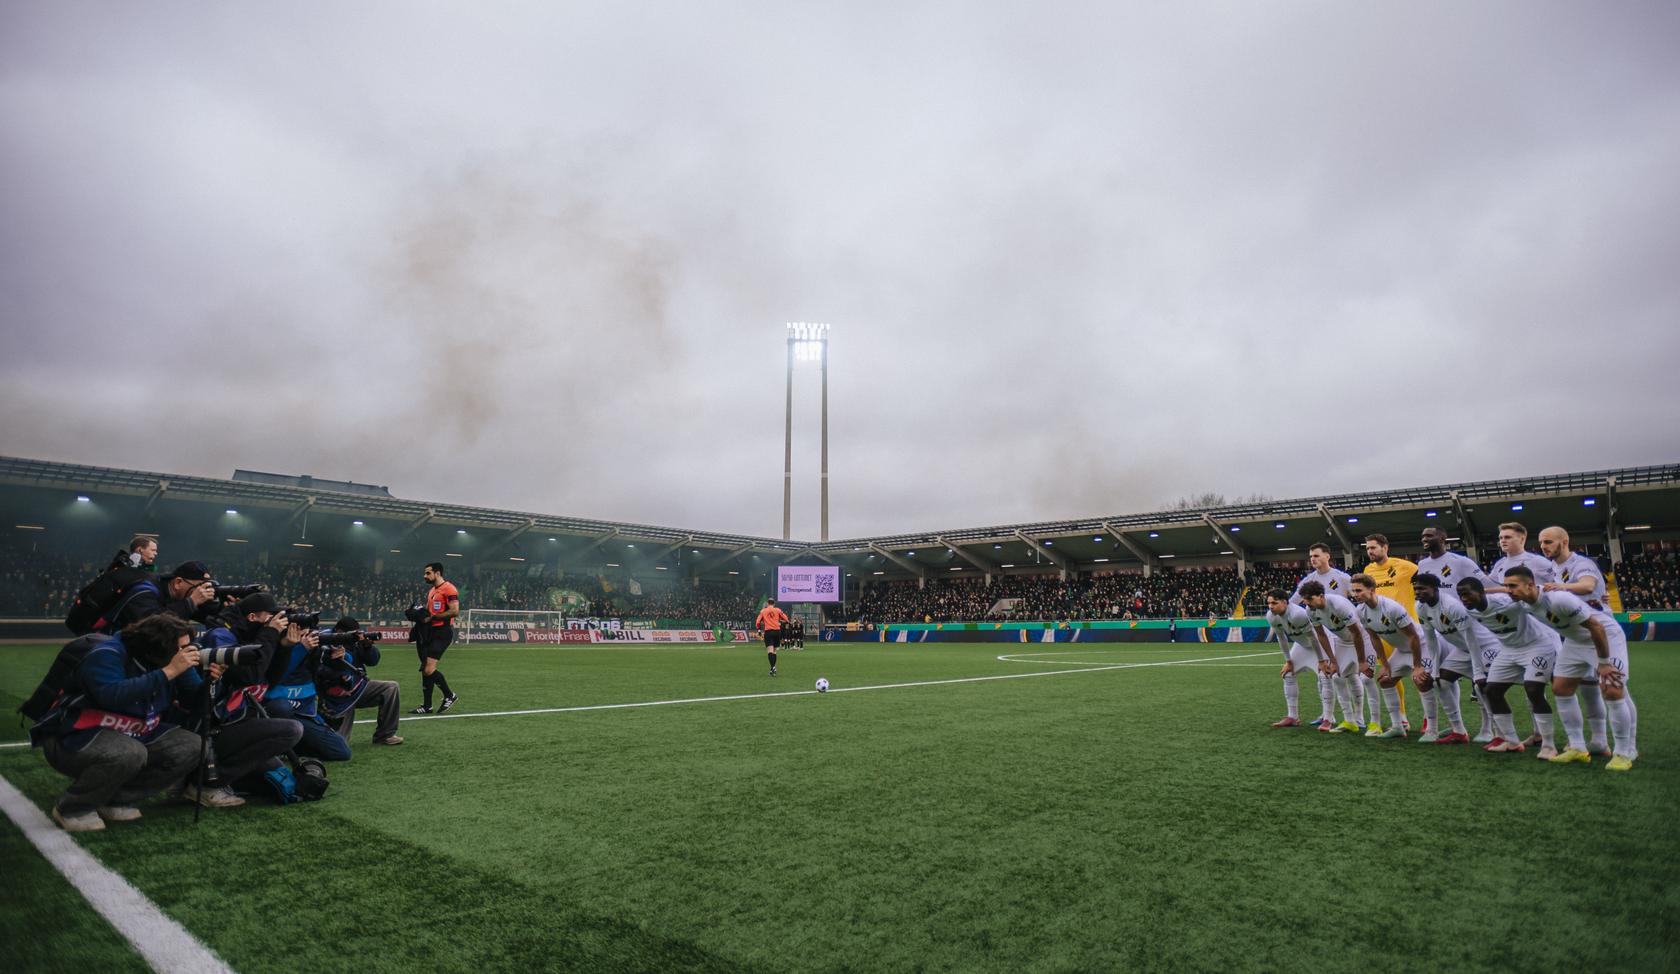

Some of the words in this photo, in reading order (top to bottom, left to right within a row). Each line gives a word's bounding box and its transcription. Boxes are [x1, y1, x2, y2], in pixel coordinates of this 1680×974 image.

[381, 631, 410, 640] ENSKA
[459, 632, 508, 641] Sandström
[563, 631, 590, 641] Finans
[287, 688, 303, 698] TV
